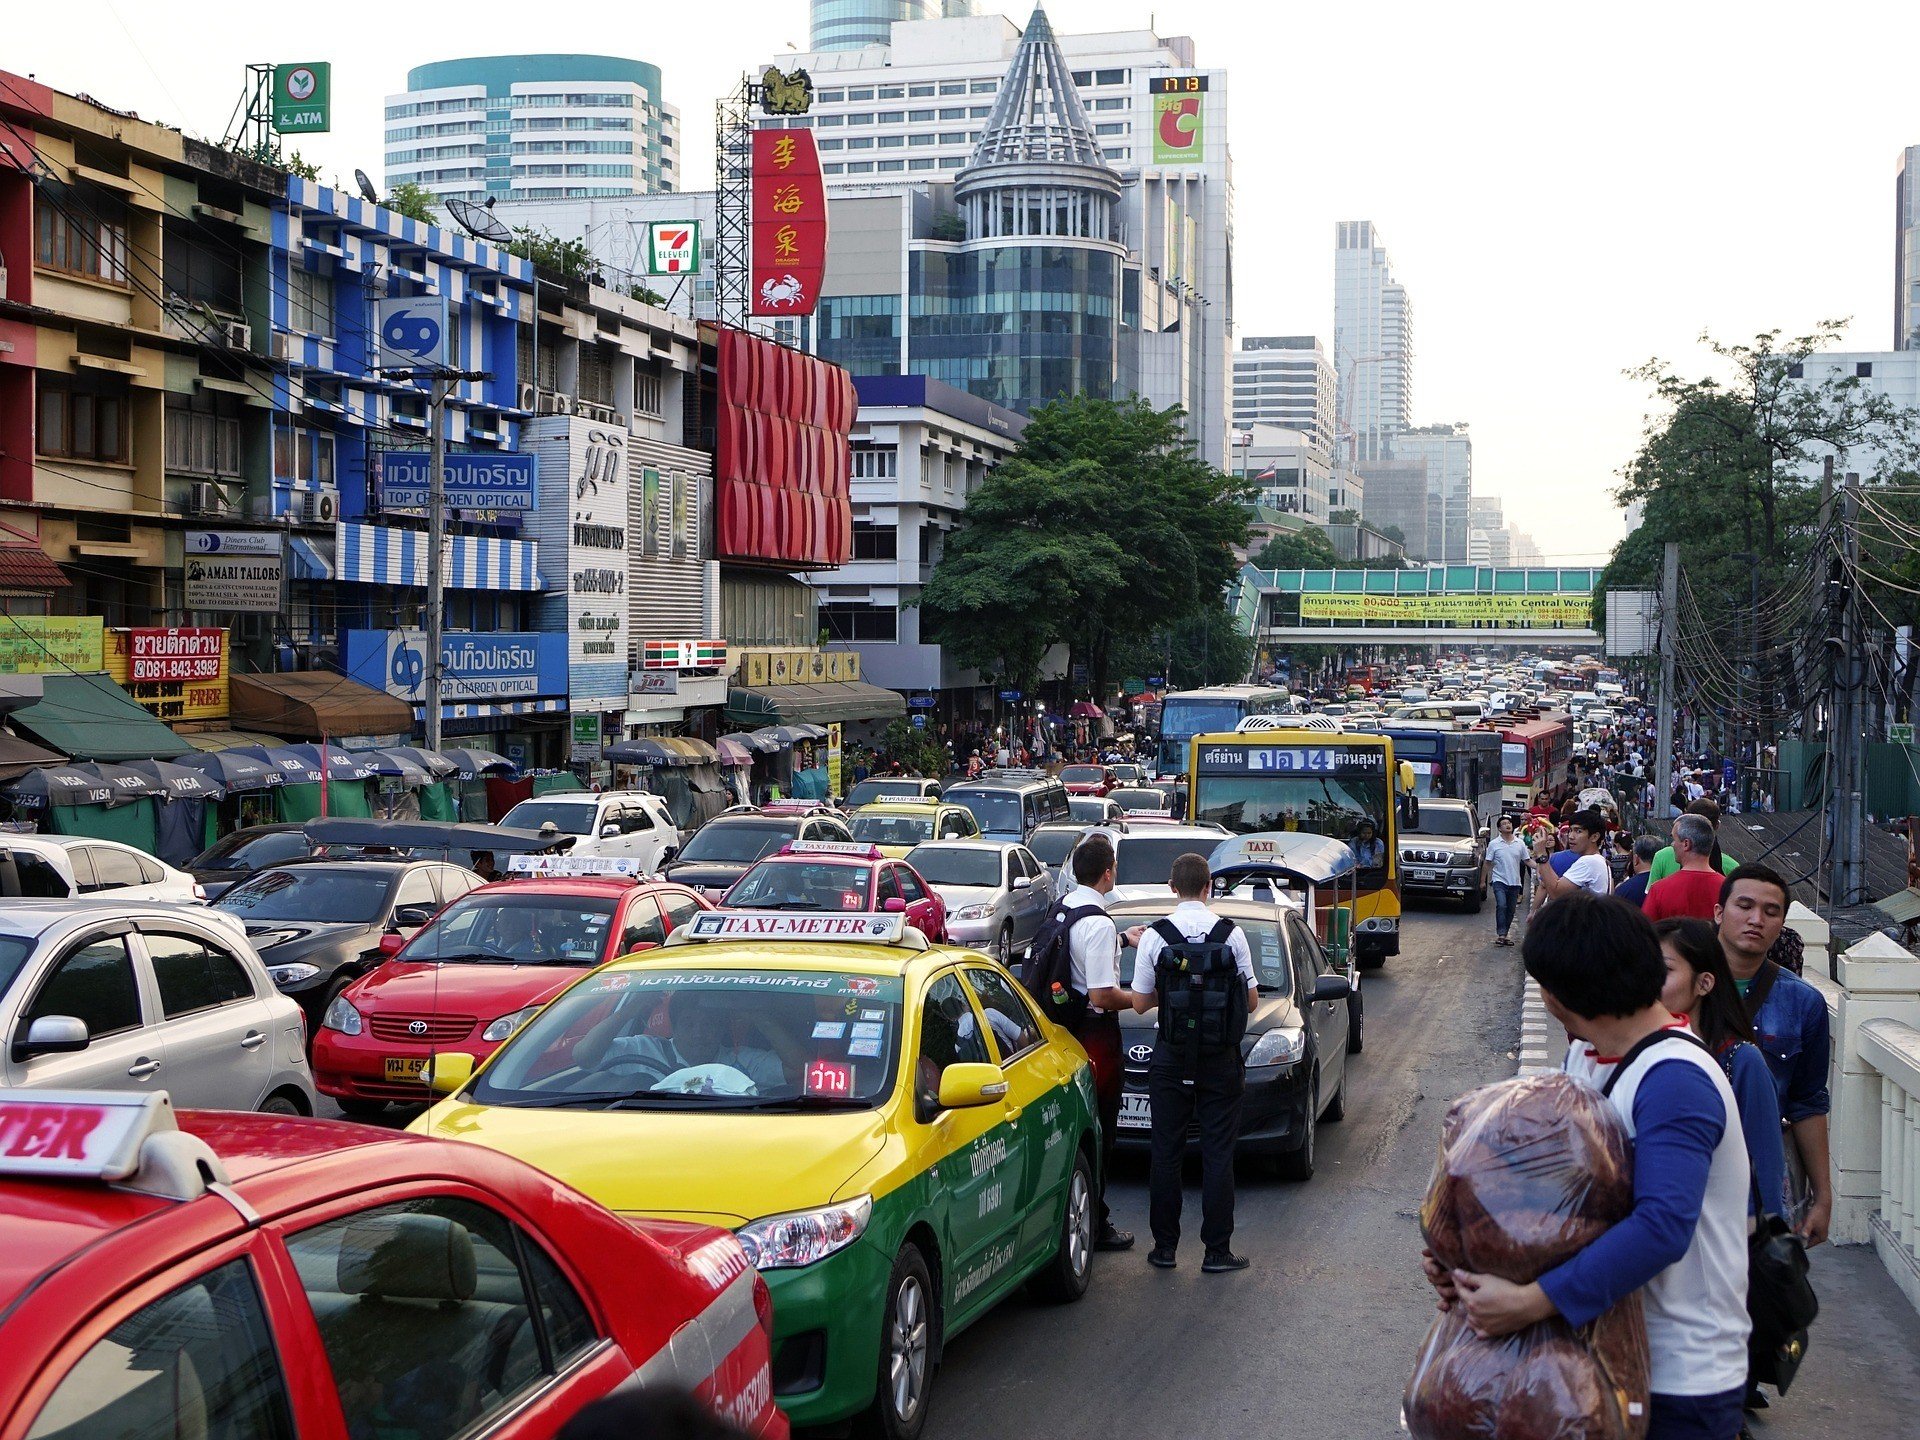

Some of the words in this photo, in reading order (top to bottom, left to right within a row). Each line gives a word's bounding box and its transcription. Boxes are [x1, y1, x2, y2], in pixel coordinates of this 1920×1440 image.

[1159, 100, 1183, 115] Big
[294, 111, 323, 125] ATM
[388, 491, 412, 504] TOP
[416, 492, 472, 506] CHROEN
[476, 494, 528, 507] OPTICAL
[206, 566, 238, 580] AMARI
[240, 567, 280, 581] TAILORS
[1521, 598, 1560, 608] Central
[134, 628, 220, 655] ขายตึกด่วน
[146, 659, 219, 678] 081-843-3982
[456, 680, 498, 694] CHAROEN
[500, 679, 535, 692] OPTICAL
[188, 688, 222, 707] FREE
[280, 760, 305, 770] VISA
[330, 756, 353, 766] VISA
[646, 756, 663, 765] VISA
[1204, 749, 1243, 764] ศรีย่าน
[1300, 750, 1329, 771] 14
[53, 775, 88, 787] VISA
[113, 776, 146, 788] VISA
[171, 777, 202, 791] VISA
[264, 773, 283, 784] VISA
[15, 793, 40, 807] VISA
[89, 788, 111, 801] VISA
[1247, 841, 1274, 852] TAXI
[724, 917, 868, 934] TAXI-METER
[811, 1062, 846, 1090] ว่าง
